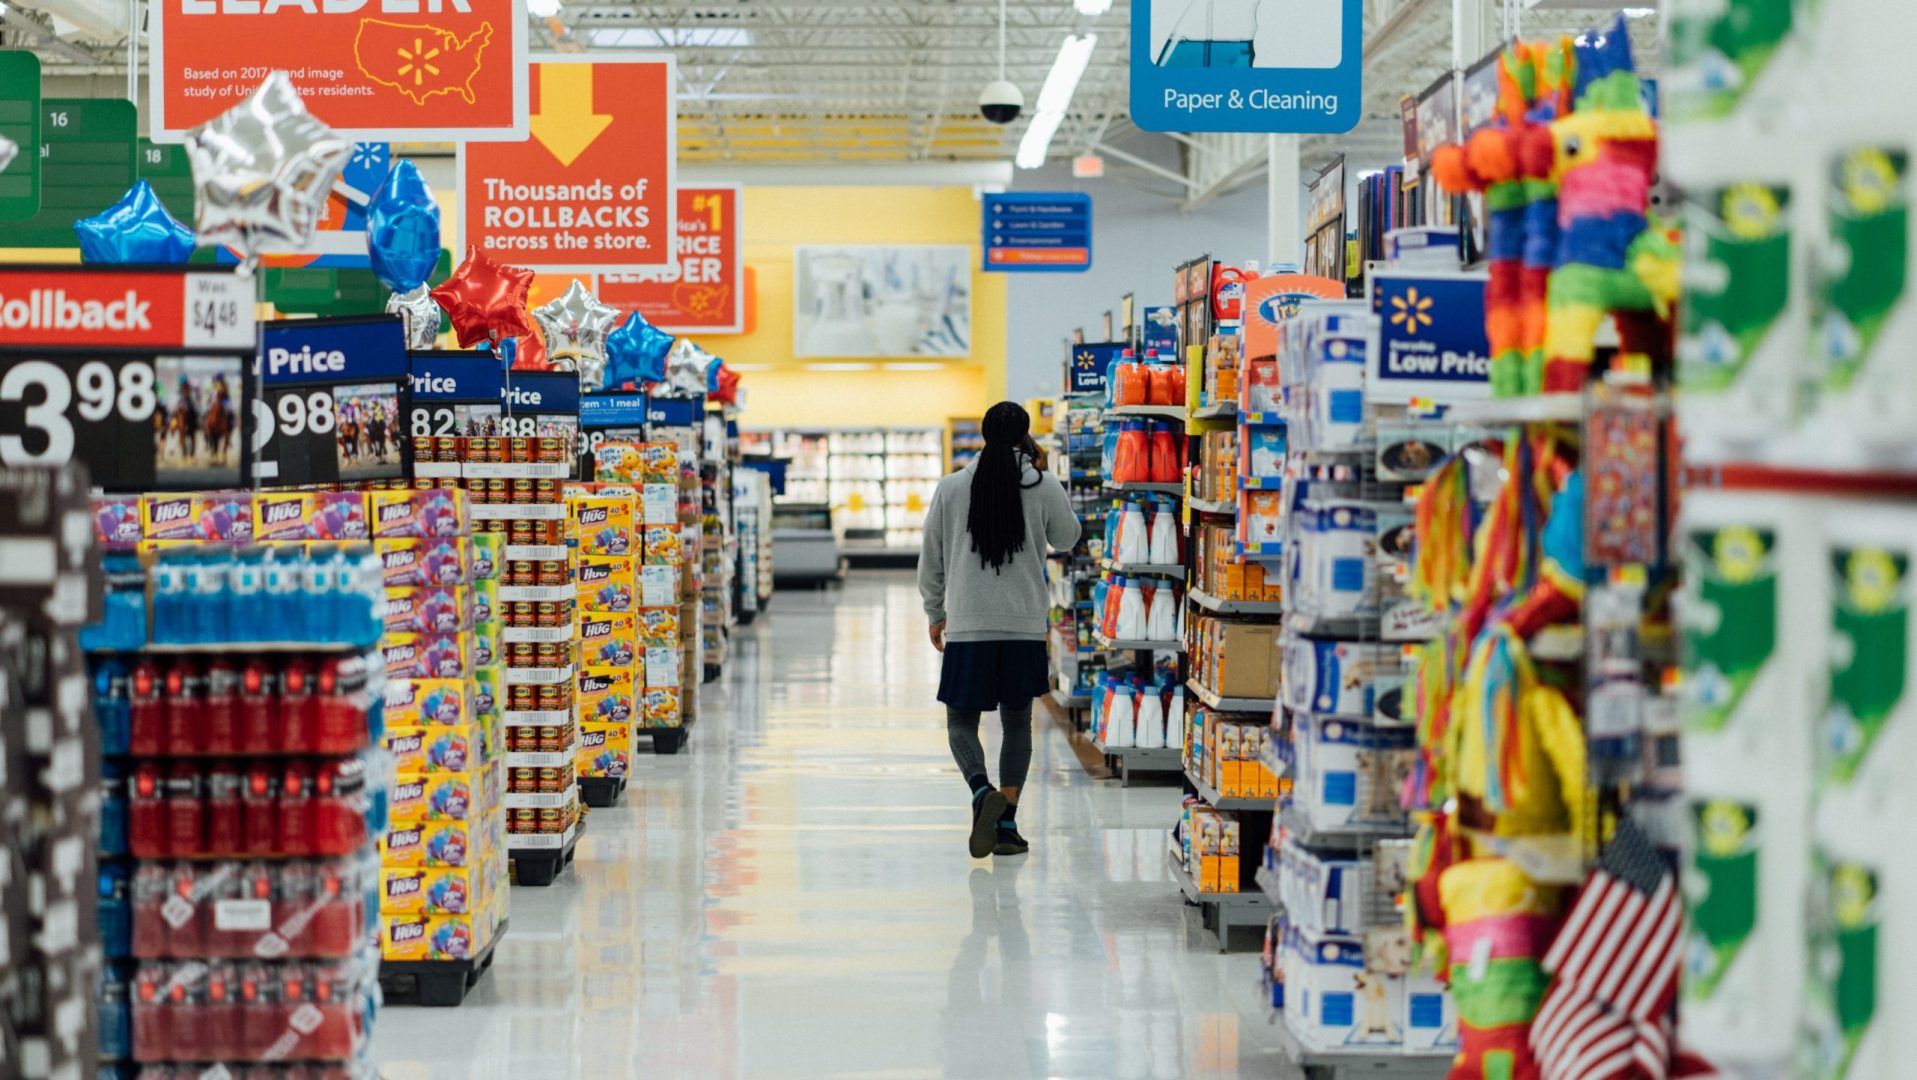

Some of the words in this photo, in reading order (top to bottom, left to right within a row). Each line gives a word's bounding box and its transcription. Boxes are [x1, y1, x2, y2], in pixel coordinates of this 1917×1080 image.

[183, 68, 219, 79] Based
[222, 70, 237, 79] on
[240, 67, 267, 80] 2017
[307, 67, 344, 82] image
[183, 86, 216, 100] study
[219, 85, 232, 97] of
[318, 86, 375, 97] residents.
[1164, 88, 1223, 113] Paper
[1228, 88, 1244, 109] &
[1249, 88, 1338, 115] Cleaning
[50, 112, 68, 127] 16
[145, 149, 162, 164] 18
[483, 177, 615, 201] Thousands
[620, 177, 648, 201] of
[484, 205, 650, 229] ROLLBACKS
[484, 234, 549, 249] across
[554, 232, 588, 249] the
[594, 232, 651, 249] store.
[676, 236, 721, 255] RICE
[268, 345, 346, 375] Price
[1388, 351, 1440, 373] Low
[1441, 350, 1492, 375] Pric
[617, 398, 640, 408] meal
[155, 503, 189, 522] HUG
[267, 502, 301, 522] HUG
[382, 504, 411, 522] HUG
[581, 510, 606, 524] HUG
[586, 624, 610, 637] HUG
[391, 737, 420, 754] HUG
[581, 734, 605, 747] HUG
[390, 831, 419, 848] HUG
[390, 879, 419, 896] HUG
[394, 924, 423, 941] HUG
